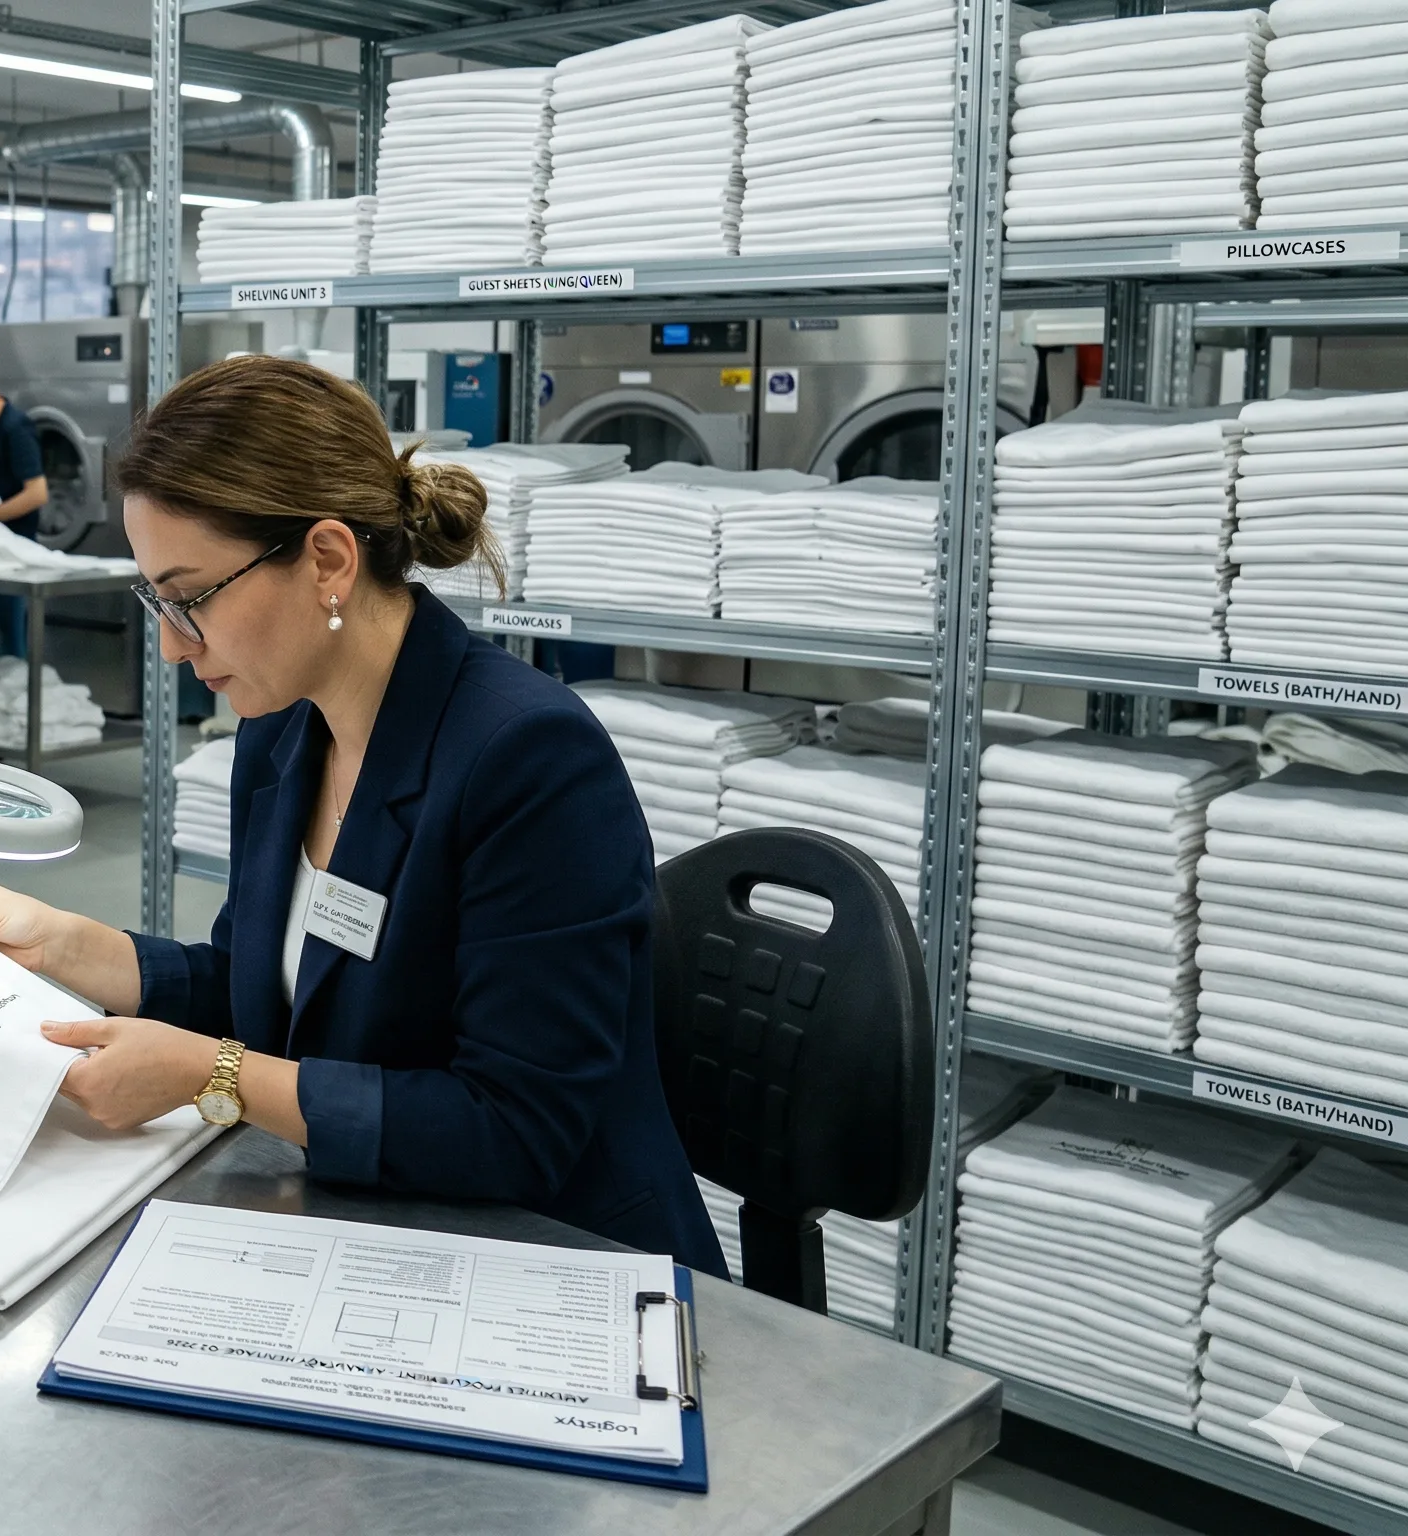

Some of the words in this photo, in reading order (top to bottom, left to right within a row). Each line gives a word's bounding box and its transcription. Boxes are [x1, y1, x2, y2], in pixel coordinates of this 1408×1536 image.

[1227, 240, 1346, 259] PILLOWCASES
[468, 279, 501, 291] GUEST
[503, 277, 542, 290] SHEETS
[238, 288, 288, 302] SHELVING
[290, 287, 317, 300] UNIT
[319, 287, 327, 299] 3
[492, 613, 563, 630] PILLOWCASES
[1214, 676, 1280, 695] TOWELS
[1284, 682, 1402, 710] (BATH/HAND)
[1205, 1079, 1272, 1106] TOWELS
[1276, 1095, 1395, 1137] (BATH/HAND)
[553, 1414, 639, 1436] Logistyx
